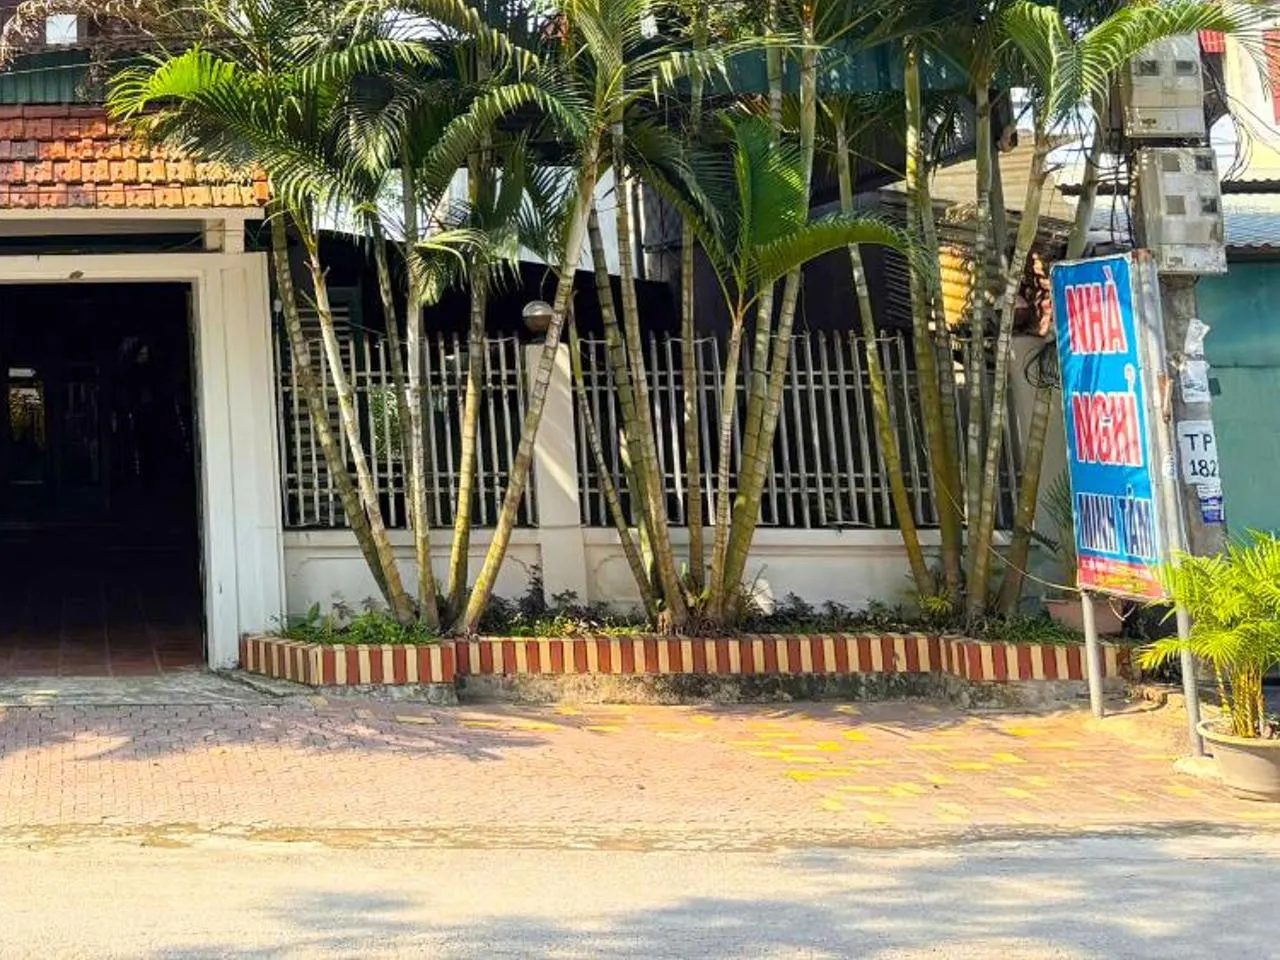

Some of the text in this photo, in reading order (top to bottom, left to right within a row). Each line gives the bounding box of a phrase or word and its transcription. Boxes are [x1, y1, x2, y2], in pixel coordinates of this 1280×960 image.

[1065, 265, 1128, 355] NHÀ
[1072, 363, 1143, 468] NGHỈ
[1183, 433, 1213, 451] TP
